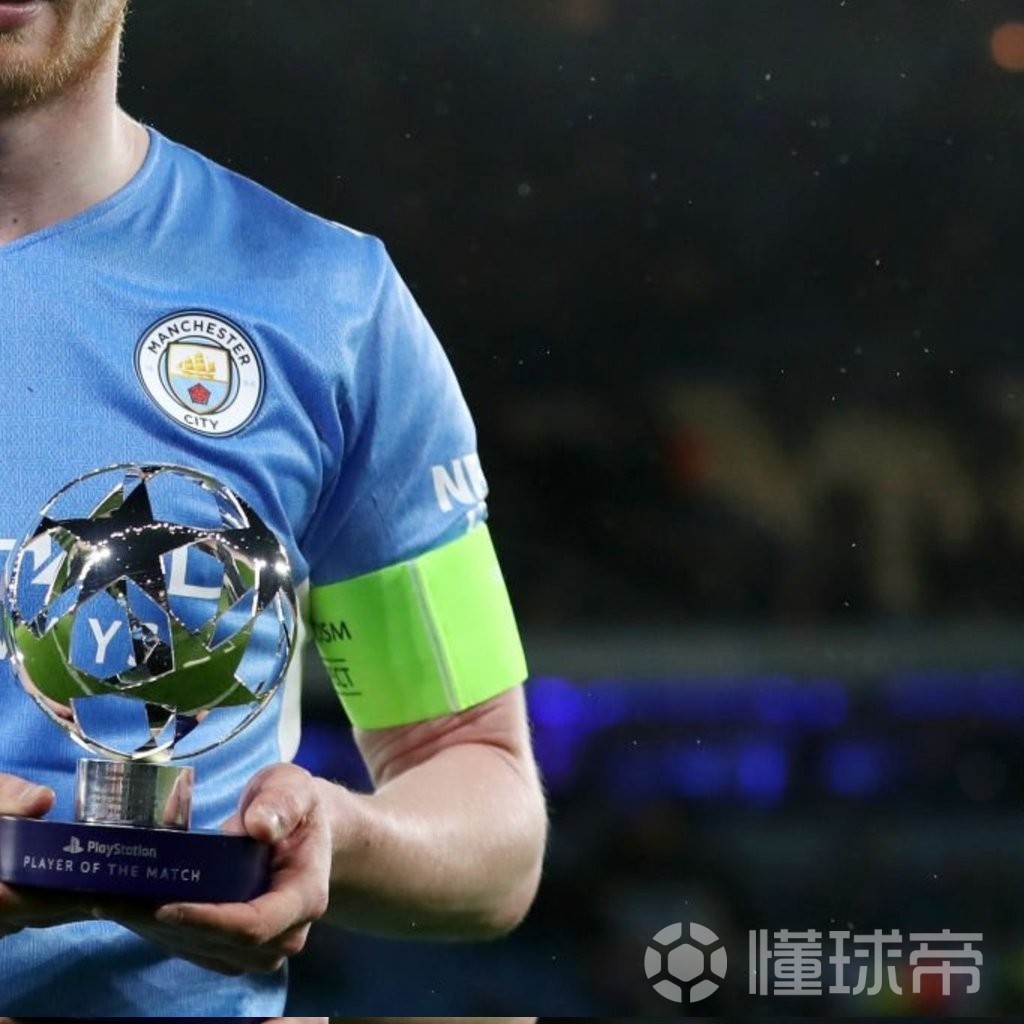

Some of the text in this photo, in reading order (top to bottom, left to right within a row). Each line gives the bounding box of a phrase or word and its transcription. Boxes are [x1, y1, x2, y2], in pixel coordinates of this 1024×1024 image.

[147, 319, 251, 366] MANCHESTER
[183, 414, 219, 430] CITY
[86, 840, 158, 859] PlayStation
[23, 855, 202, 883] PLAYER OF THE MATCH
